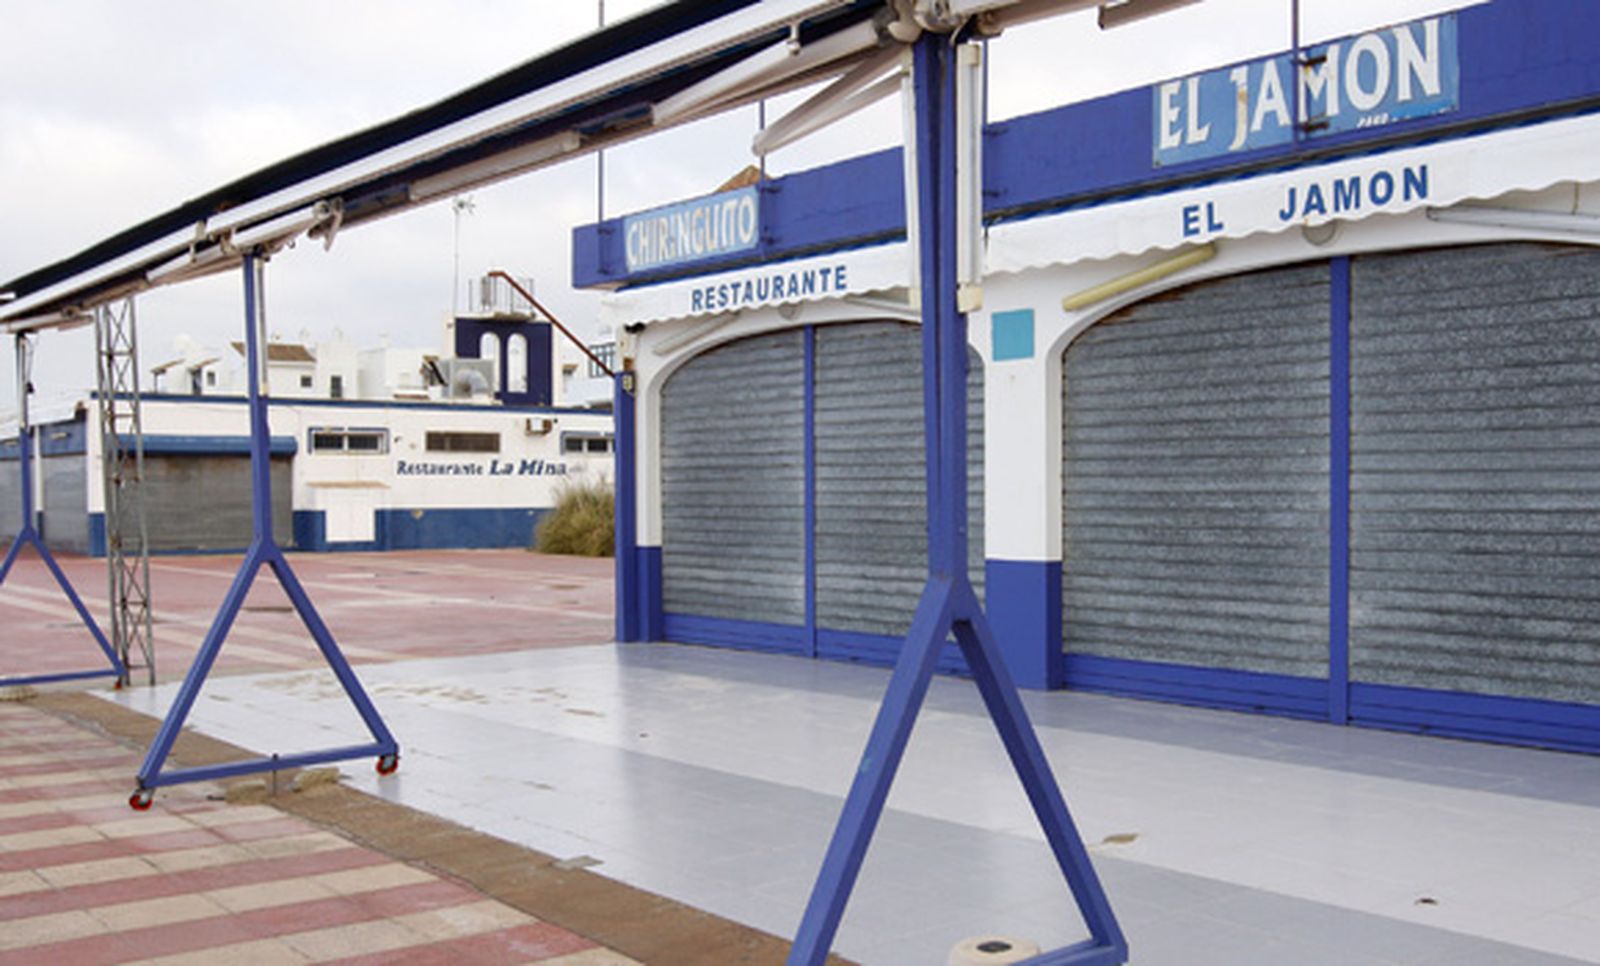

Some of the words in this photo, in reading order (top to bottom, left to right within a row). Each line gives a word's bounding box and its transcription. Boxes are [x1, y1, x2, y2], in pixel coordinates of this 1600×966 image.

[1158, 80, 1212, 150] EL
[1228, 18, 1442, 152] JAMON
[626, 195, 755, 273] CHIRINGUITO
[1182, 202, 1224, 238] EL
[1278, 165, 1429, 221] JAMON
[691, 265, 847, 312] RESTAURANTE
[397, 460, 483, 476] Restaurante
[489, 459, 514, 476] La
[518, 459, 567, 476] Mina
